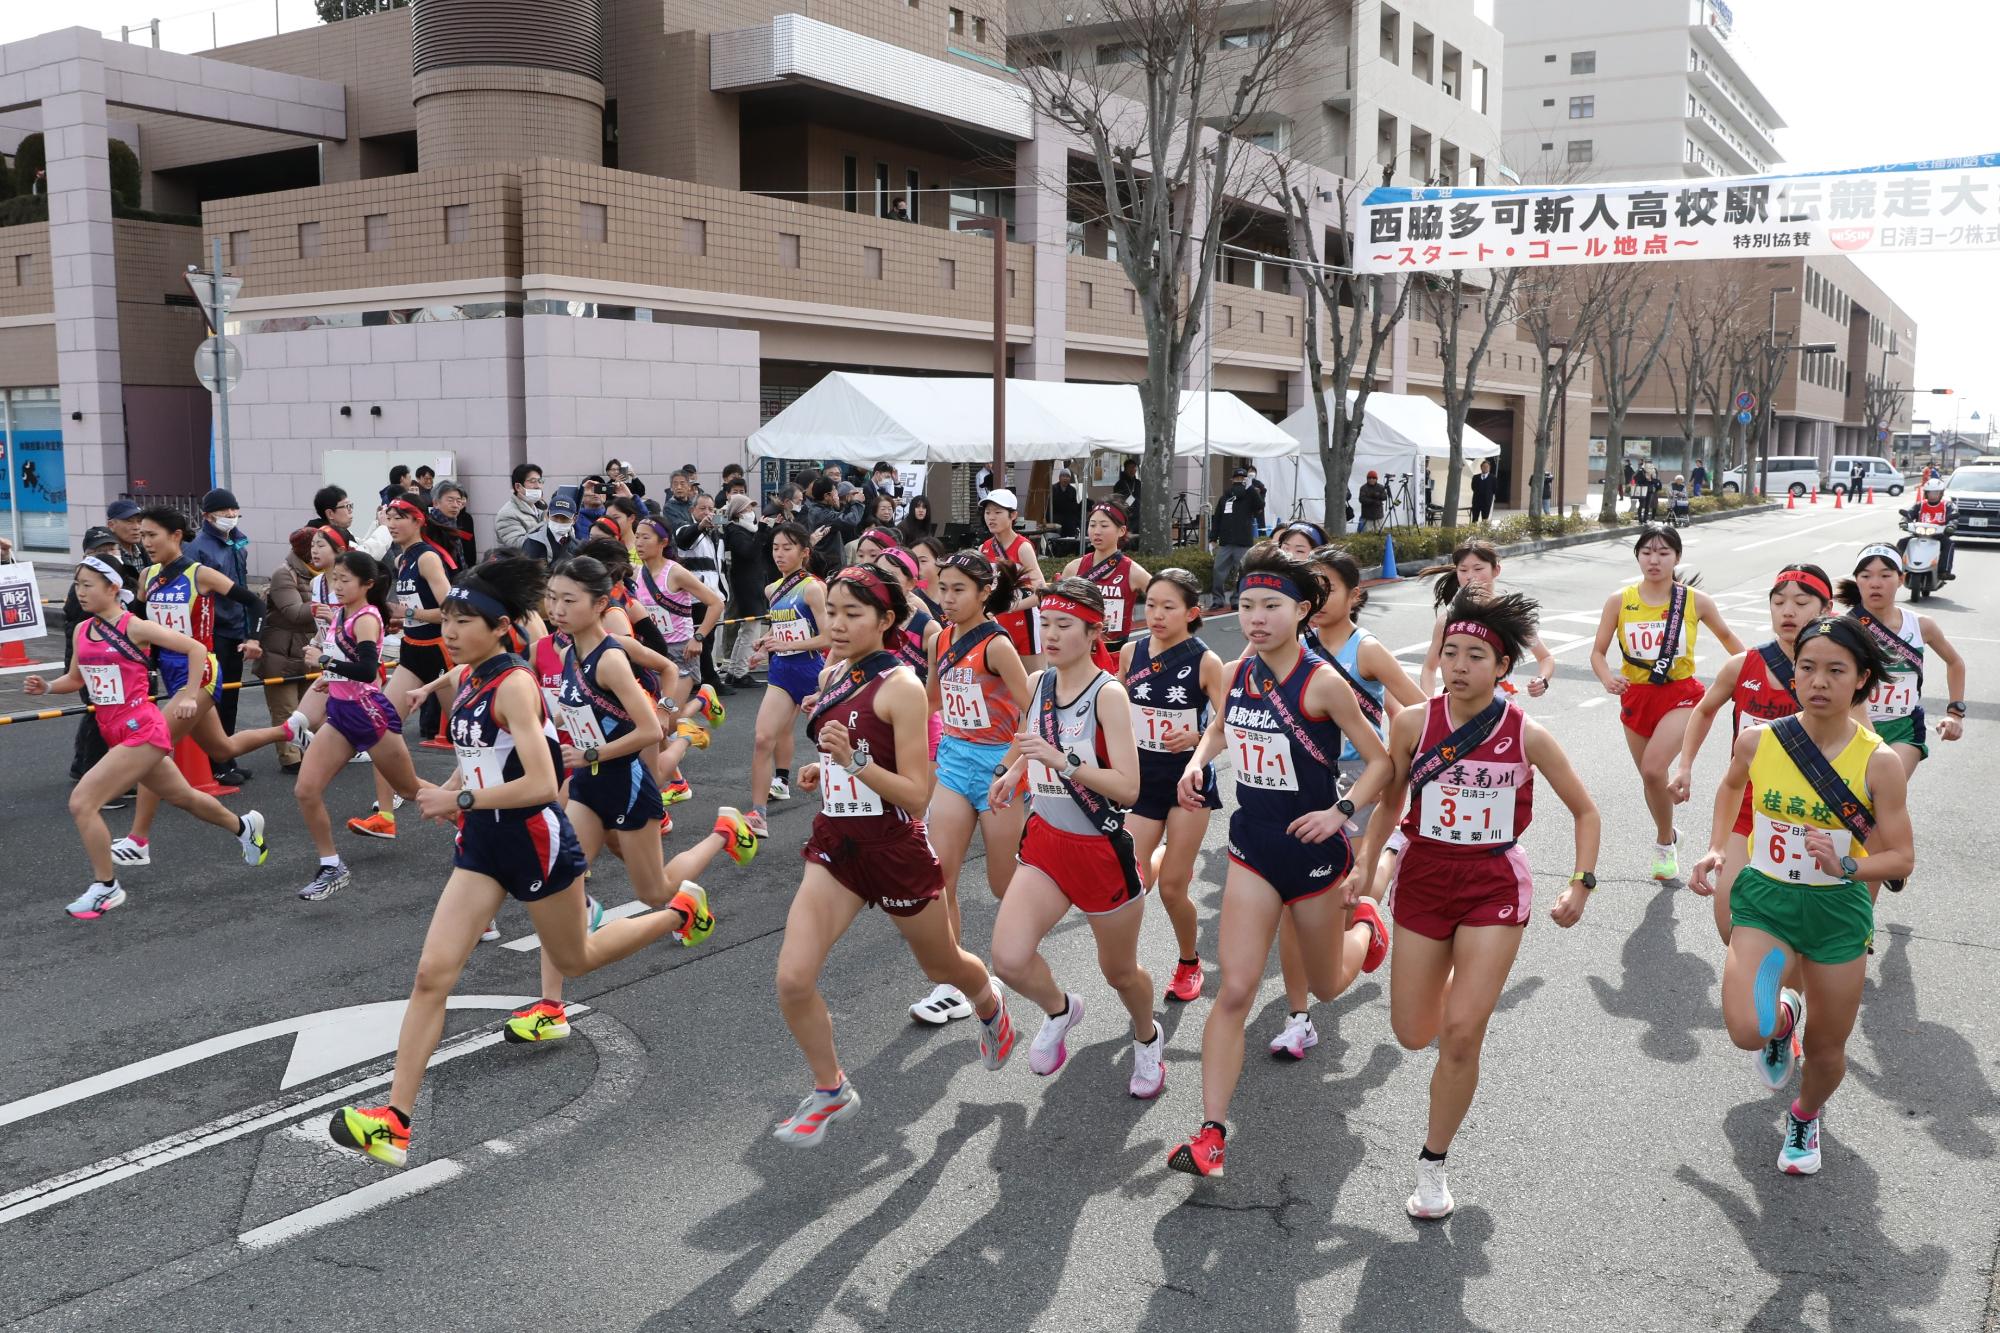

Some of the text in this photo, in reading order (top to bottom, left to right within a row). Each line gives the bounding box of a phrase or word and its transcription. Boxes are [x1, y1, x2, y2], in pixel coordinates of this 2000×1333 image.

[1369, 174, 2000, 244] 西脇多可新人高校駅伝競走大
[1733, 231, 1811, 249] 特別協賛
[1831, 229, 1872, 243] NISSIN
[1448, 621, 1488, 638] 常葉菊川
[1818, 623, 1831, 634] 桂
[1652, 657, 1670, 675] 104
[946, 692, 981, 719] 20-1
[1746, 698, 1798, 718] 加古川
[848, 710, 858, 728] R
[1147, 718, 1190, 742] 121
[1240, 742, 1287, 776] 17-1
[1434, 764, 1515, 789] 葉菊川
[1462, 788, 1499, 799] 日清ヨーク
[1439, 798, 1491, 830] 3-1
[1762, 788, 1833, 826] 桂高校
[1101, 816, 1118, 833] 15
[1431, 825, 1503, 842] 常葉菊川
[1788, 869, 1801, 881] 桂
